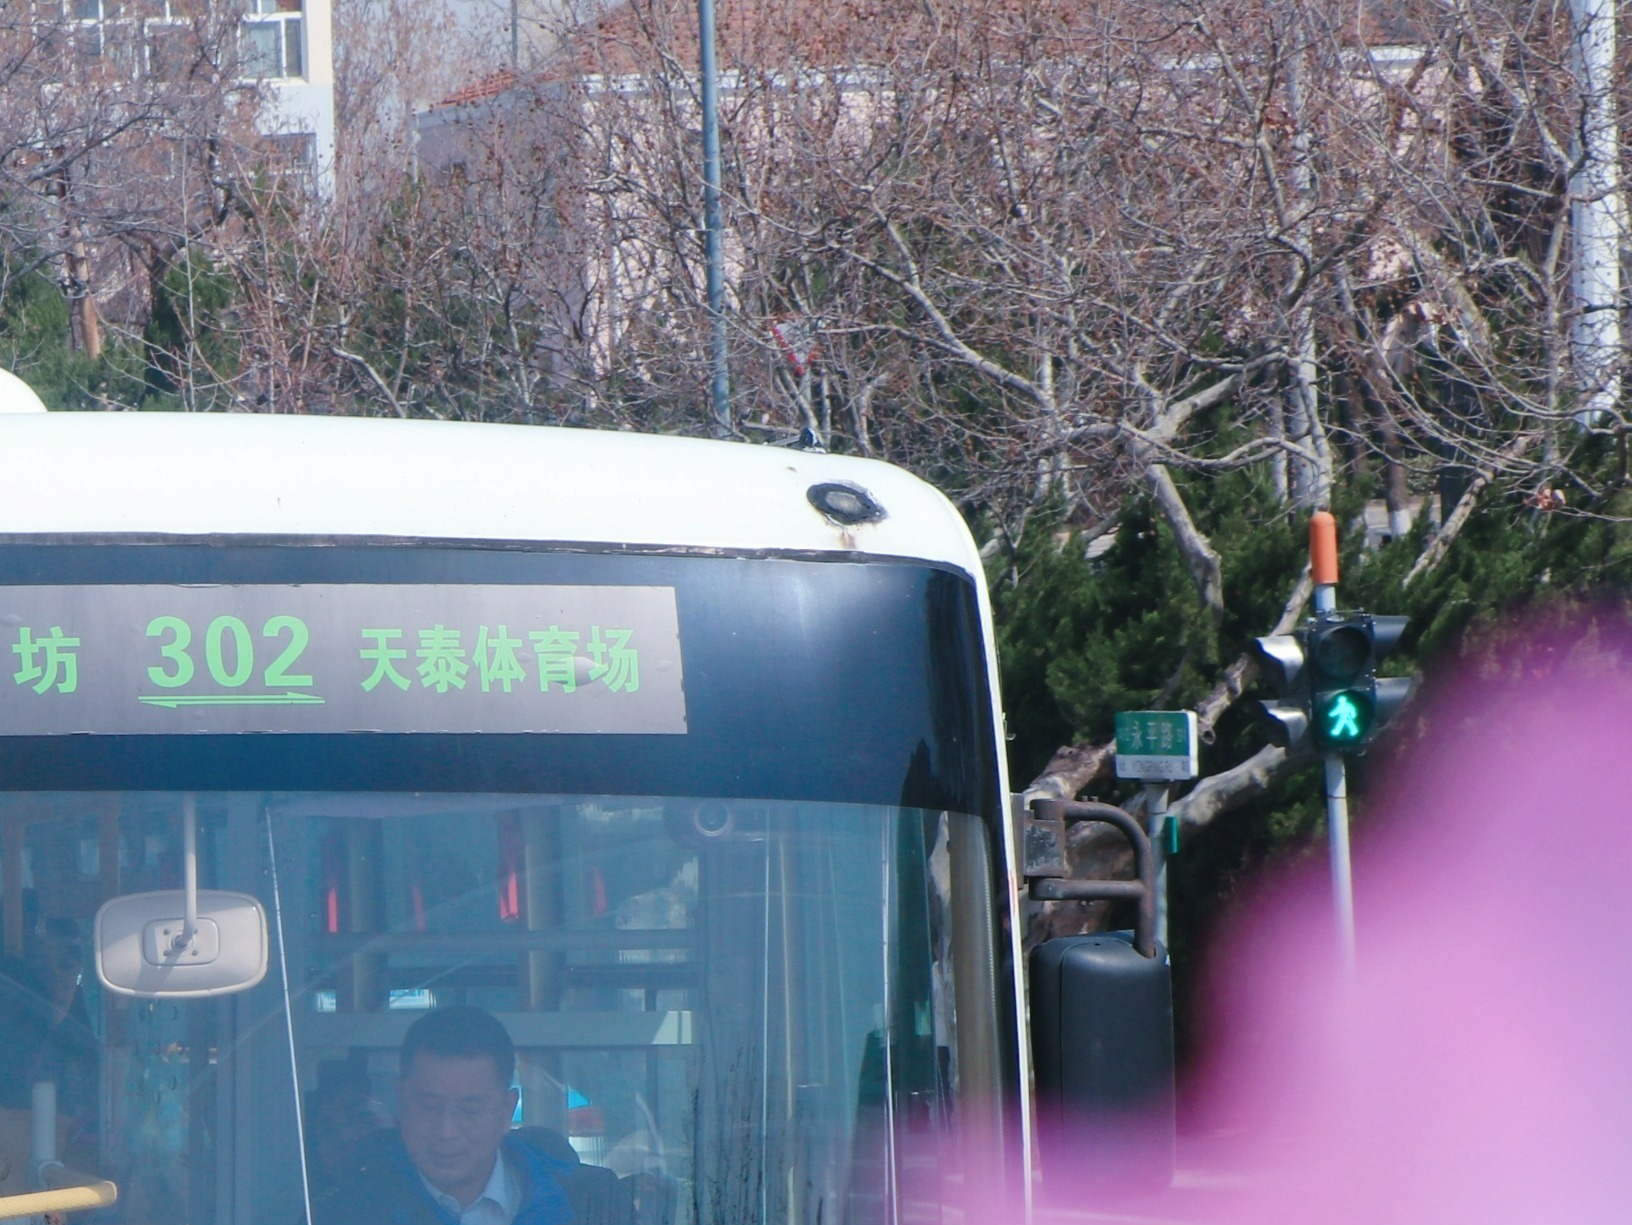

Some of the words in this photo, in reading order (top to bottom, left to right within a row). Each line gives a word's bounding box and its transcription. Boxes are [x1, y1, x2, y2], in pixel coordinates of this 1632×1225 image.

[144, 615, 315, 690] 302
[359, 623, 641, 694] 天泰体育场
